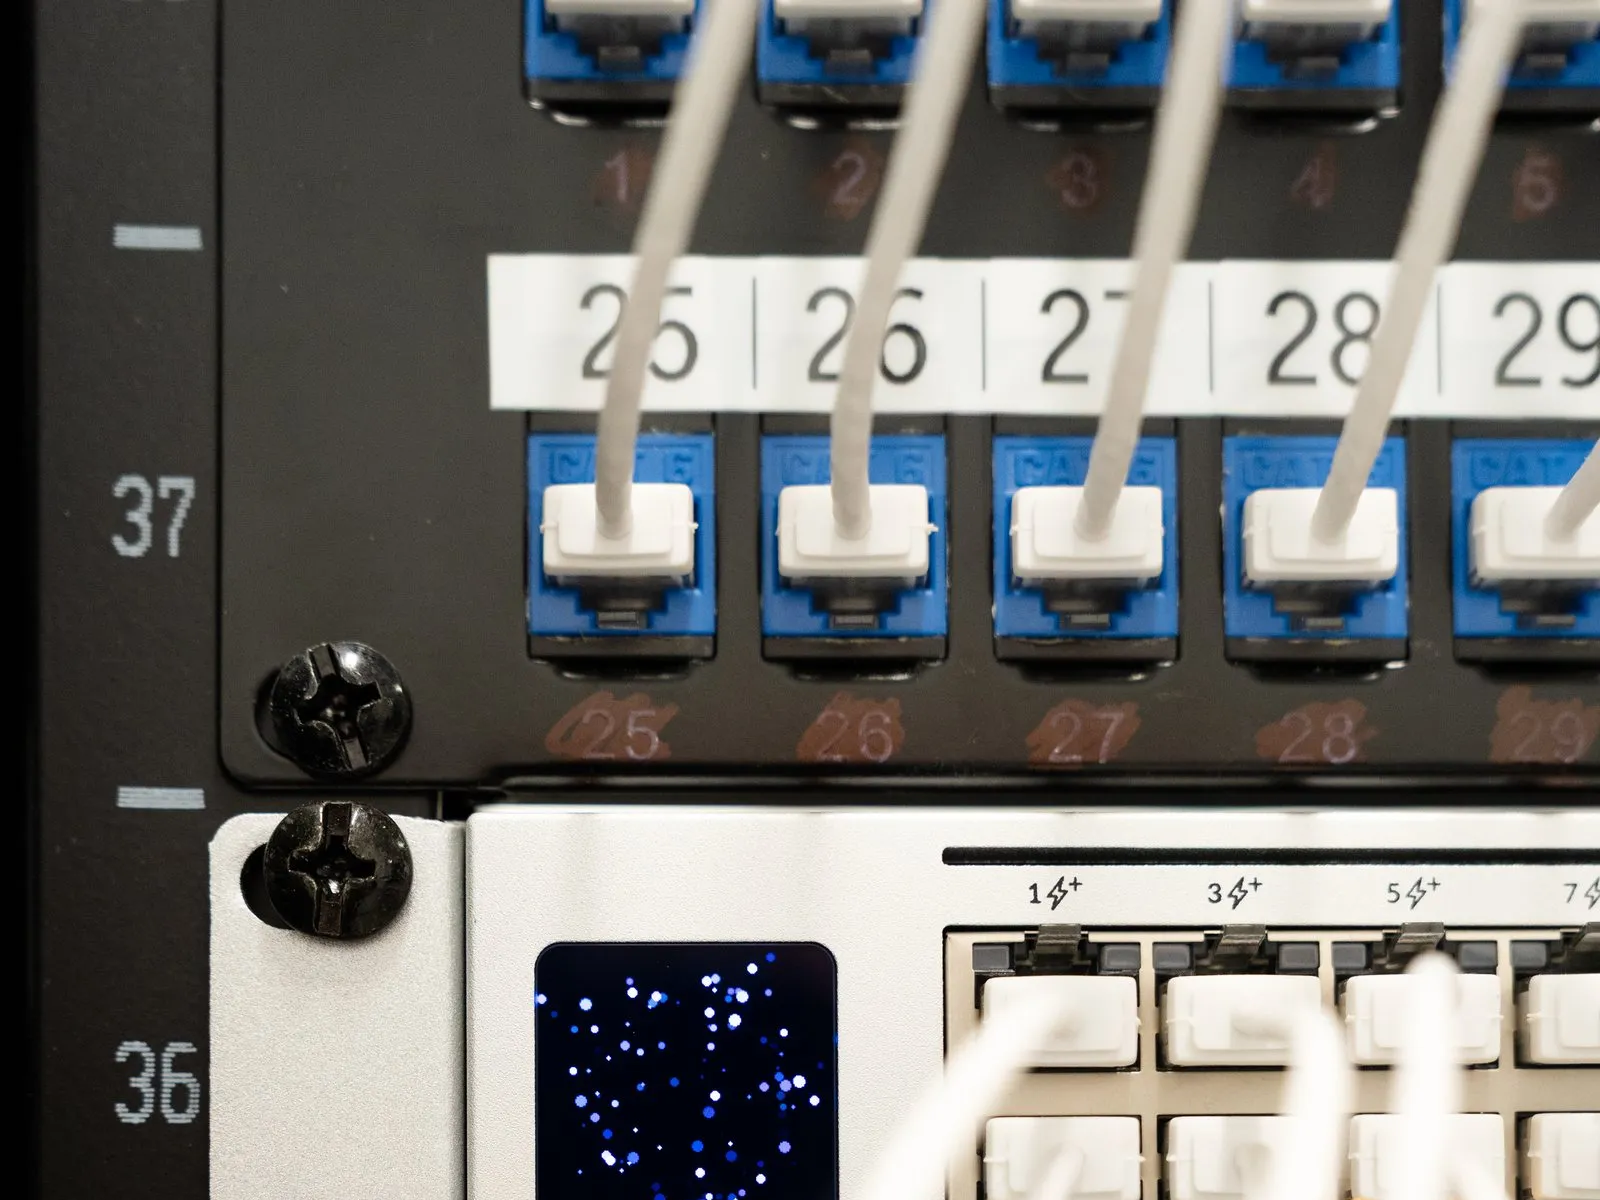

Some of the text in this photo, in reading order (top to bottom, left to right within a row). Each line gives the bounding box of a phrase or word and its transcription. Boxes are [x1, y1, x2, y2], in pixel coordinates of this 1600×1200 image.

[831, 152, 867, 205] 2
[1060, 152, 1098, 208] 3
[805, 287, 927, 385] 26
[1265, 290, 1381, 386] 28
[1493, 292, 1600, 388] 29
[111, 475, 195, 557] 37
[580, 709, 659, 761] 25
[815, 710, 893, 762] 26
[1047, 711, 1124, 763] 27
[1278, 711, 1356, 763] 28
[1508, 711, 1584, 763] 29
[114, 1040, 200, 1124] 36
